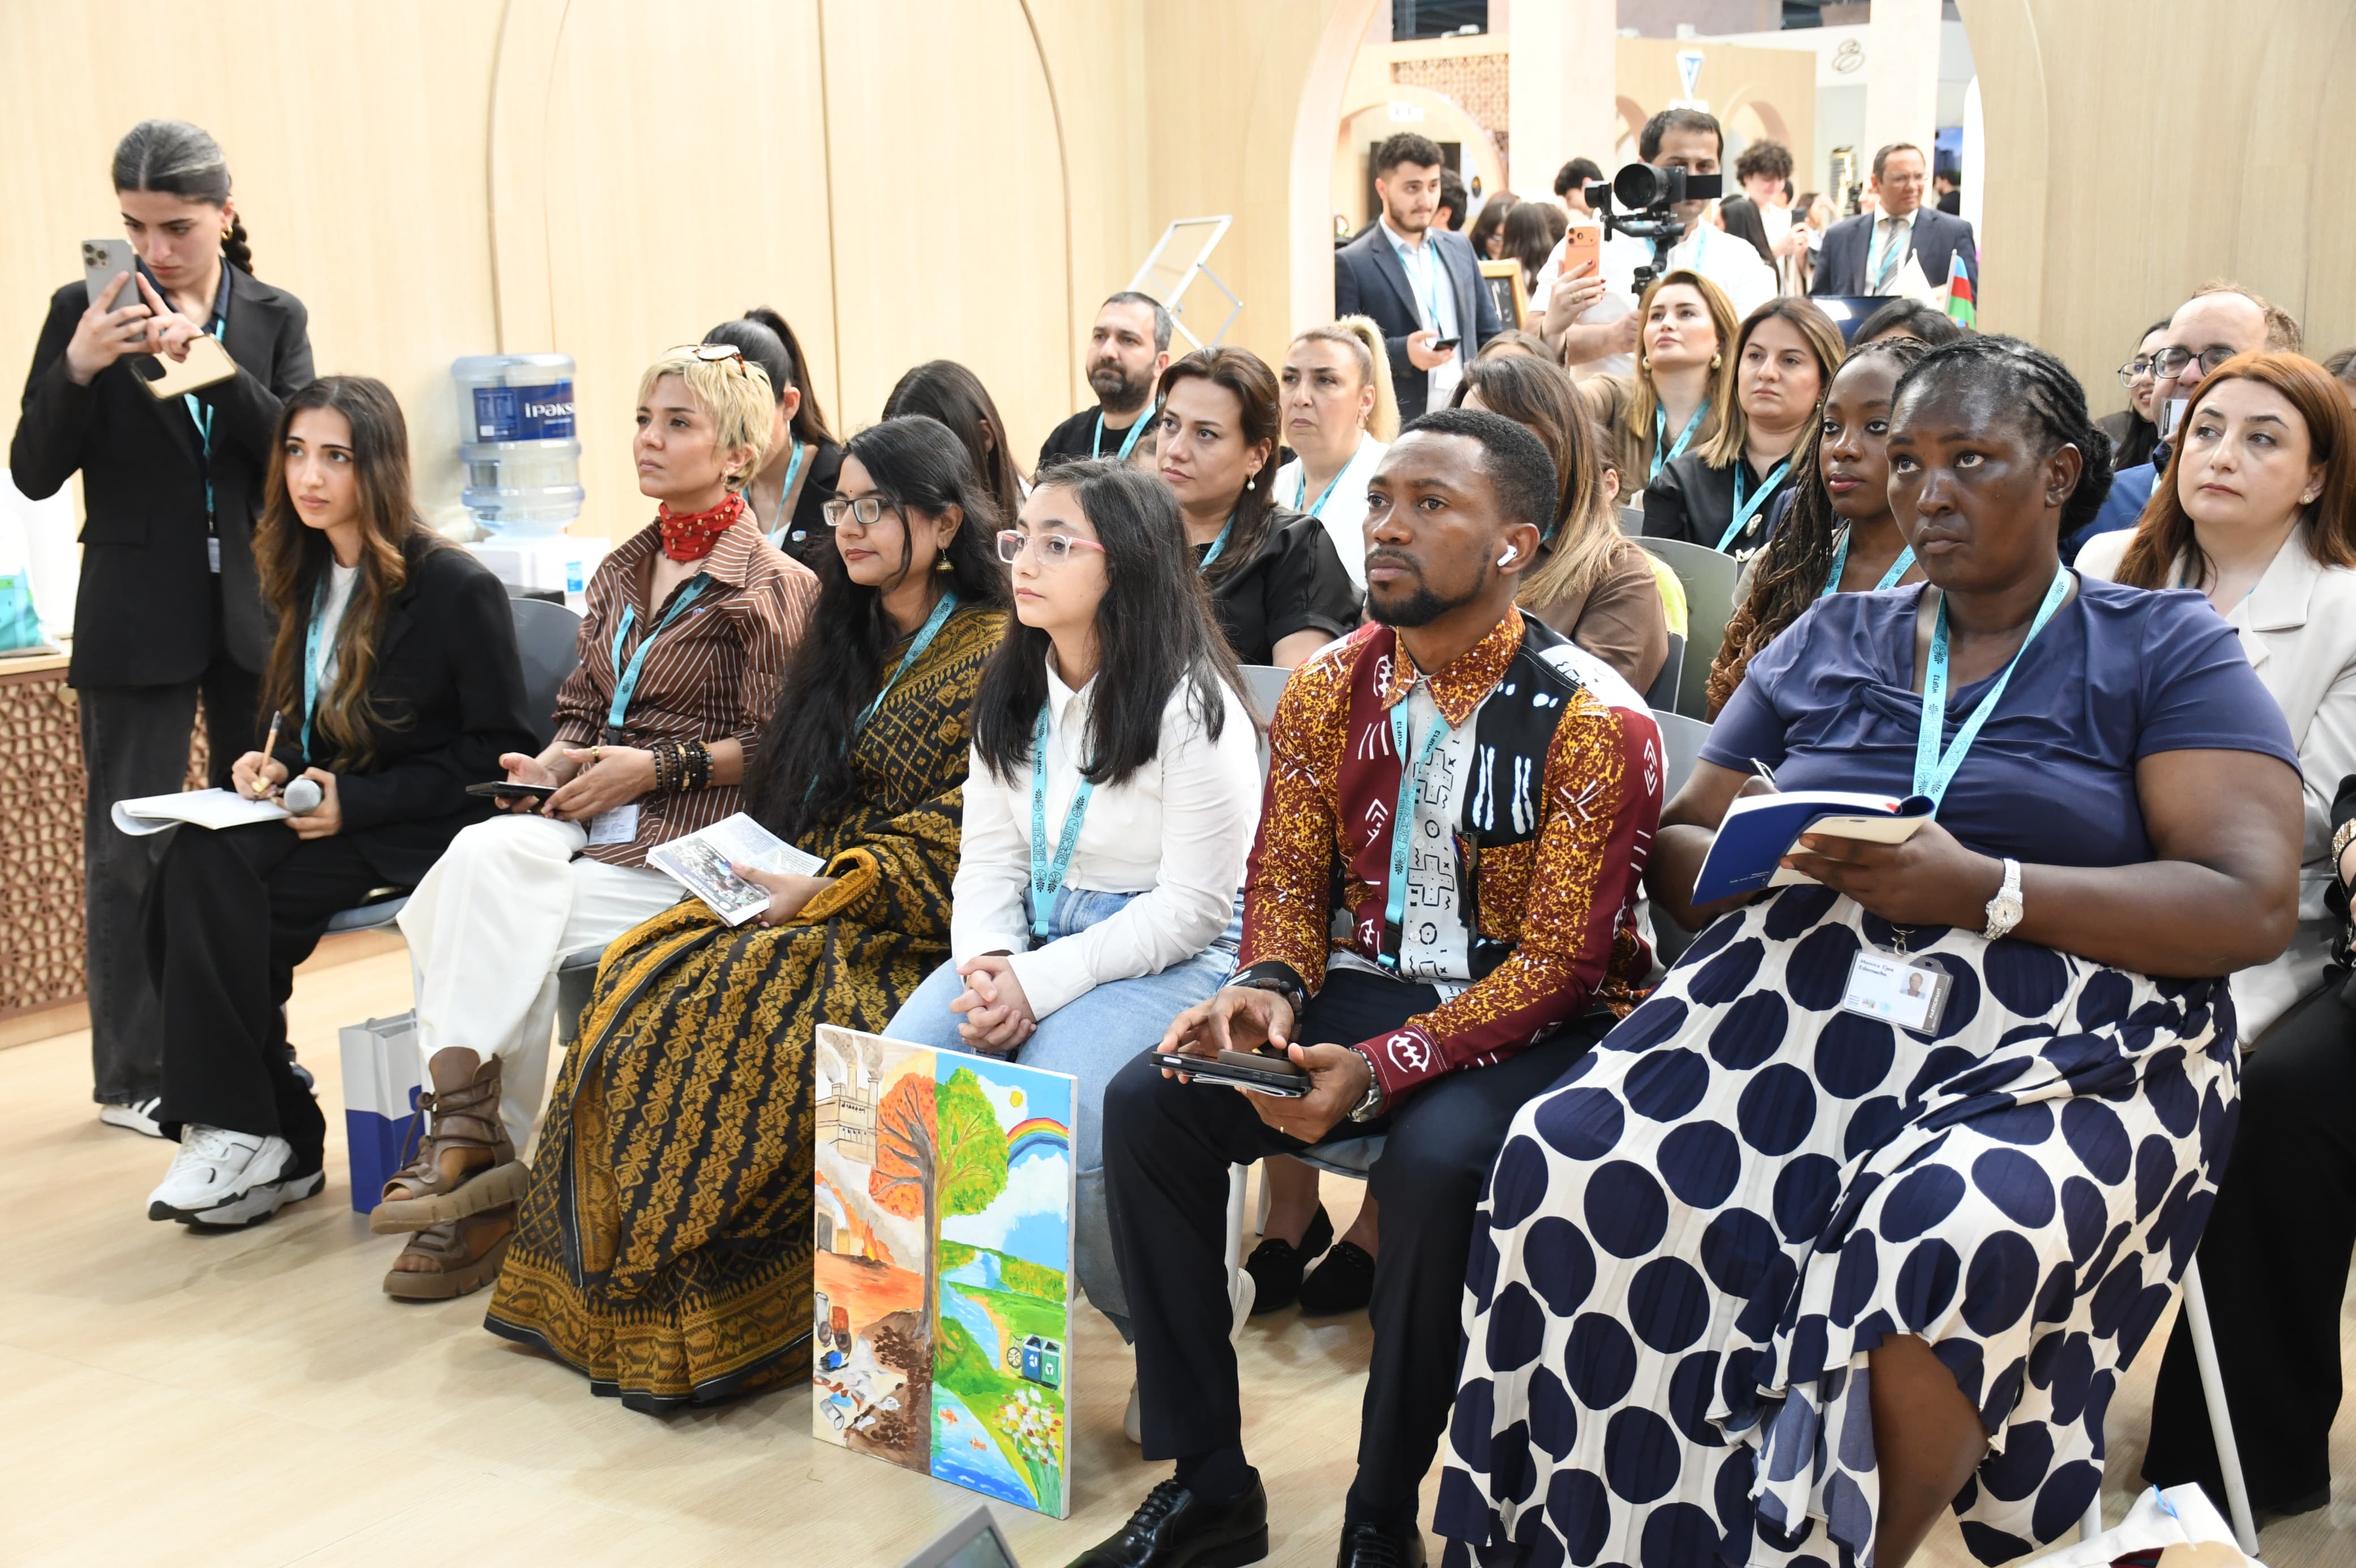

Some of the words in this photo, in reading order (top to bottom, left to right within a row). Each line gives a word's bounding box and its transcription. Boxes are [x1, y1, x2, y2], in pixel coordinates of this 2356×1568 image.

[1932, 674, 1940, 694] WUF13
[1425, 730, 1441, 753] WUF13
[1928, 987, 1942, 1019] PARTICIPANT
